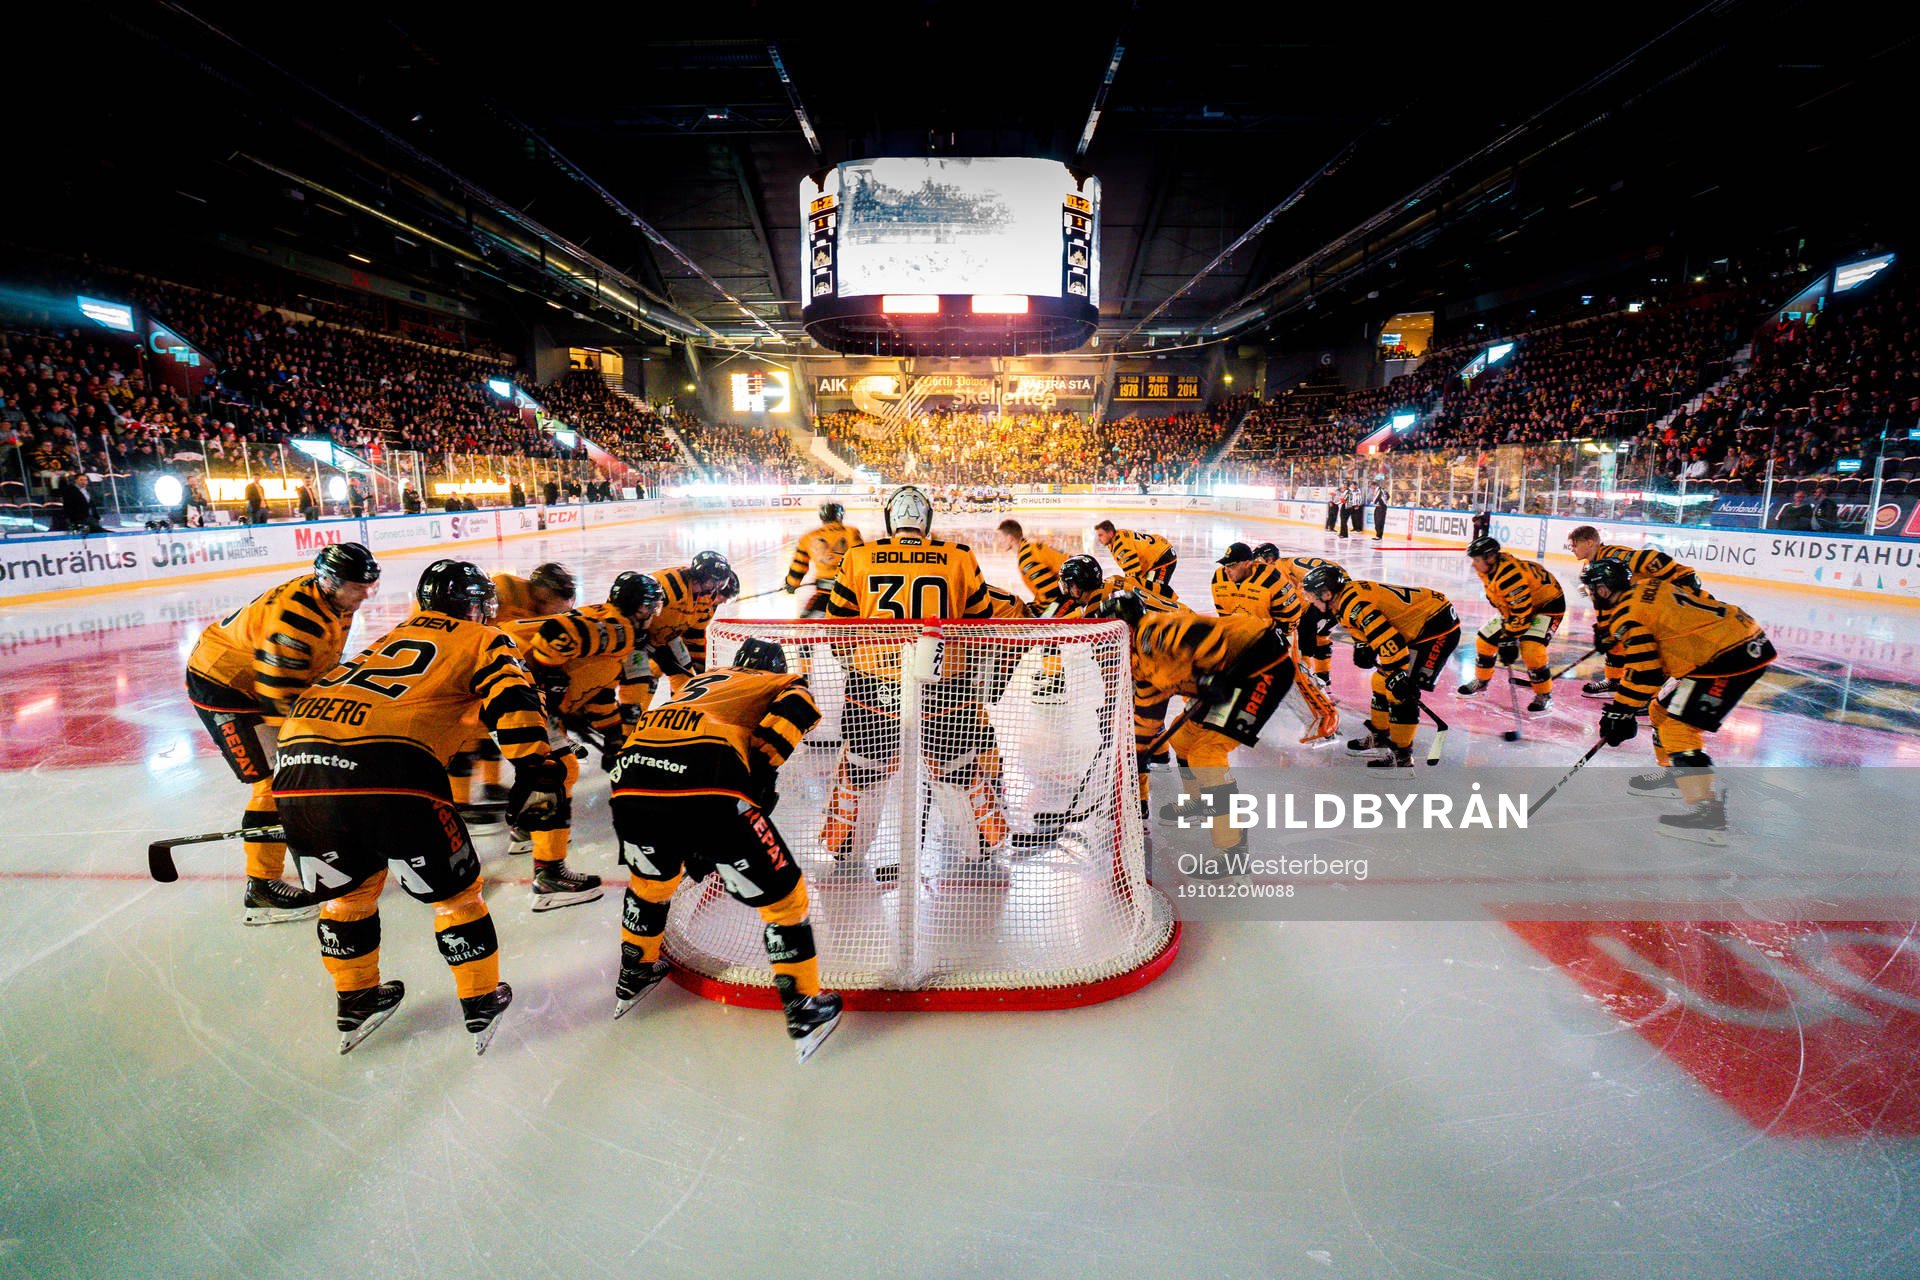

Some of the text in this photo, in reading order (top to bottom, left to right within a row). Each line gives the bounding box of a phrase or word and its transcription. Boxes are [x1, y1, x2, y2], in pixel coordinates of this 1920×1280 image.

[820, 378, 848, 392] AIK
[1068, 378, 1092, 391] STÅ
[1120, 384, 1139, 397] 1978
[1147, 383, 1169, 397] 2013
[1177, 383, 1199, 397] 2014
[1717, 501, 1758, 515] Norrlands
[547, 510, 578, 524] CCM
[1417, 515, 1468, 537] BOLIDEN
[876, 552, 947, 565] BOLIDEN
[868, 575, 949, 618] 30
[1379, 639, 1400, 658] 48
[933, 641, 945, 677] SHL
[221, 720, 259, 777] REPAY
[280, 753, 358, 771] Contractor
